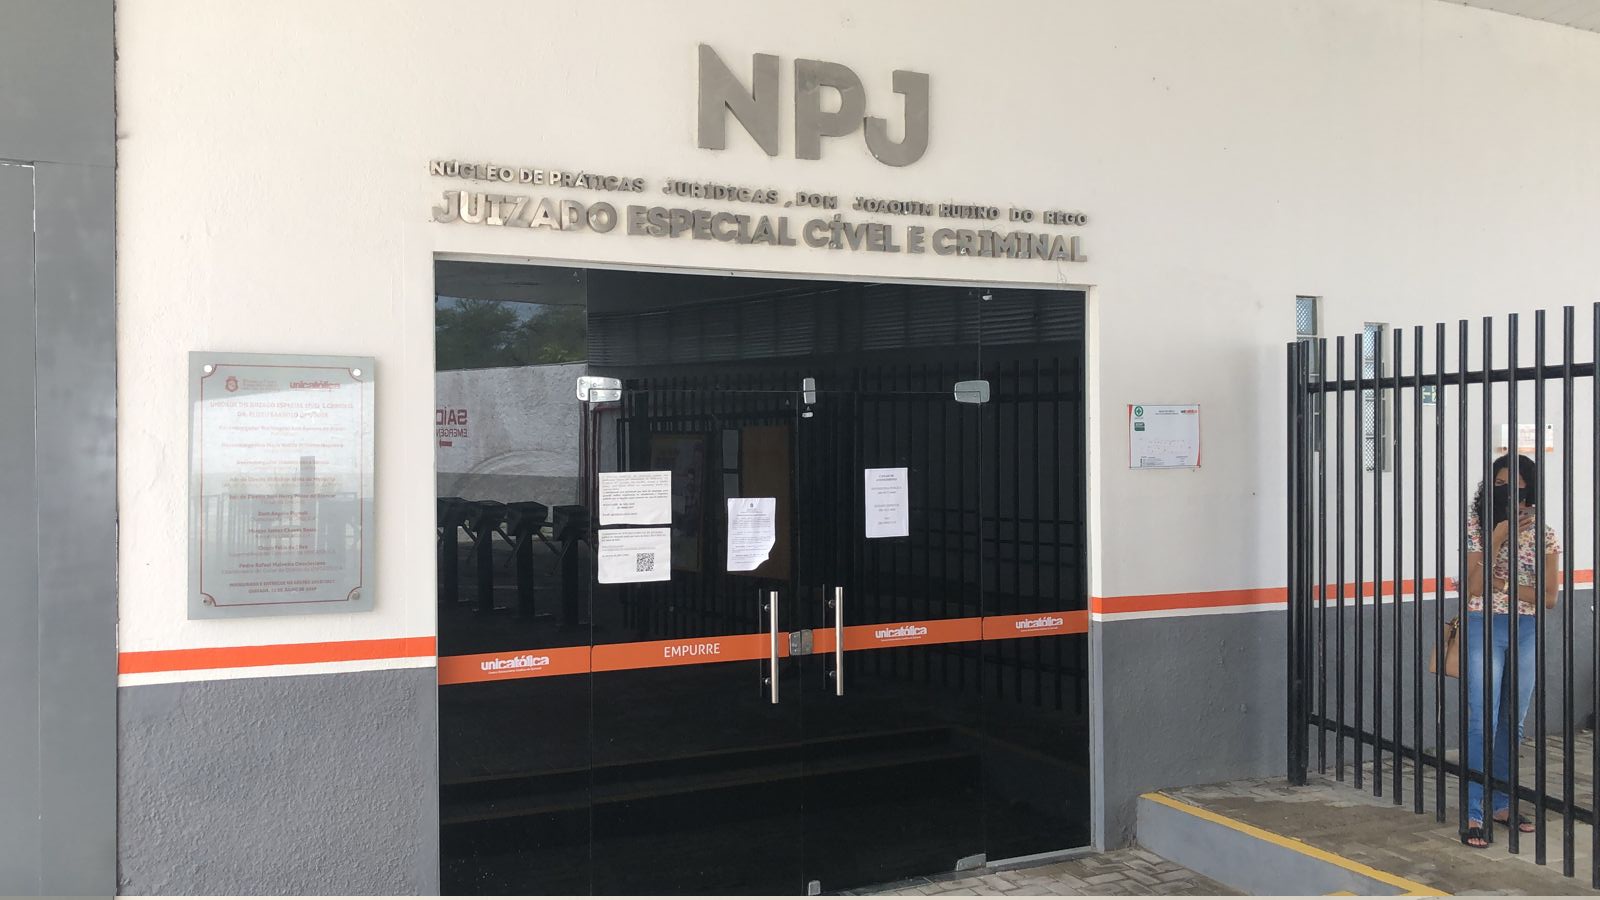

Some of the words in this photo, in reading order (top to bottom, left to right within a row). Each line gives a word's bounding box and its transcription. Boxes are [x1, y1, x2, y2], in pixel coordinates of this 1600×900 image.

[697, 42, 930, 167] NPJ
[430, 160, 514, 183] NÚCLEO
[519, 167, 544, 185] DE
[550, 170, 647, 193] PRÁTICAS
[795, 191, 838, 210] DOM
[853, 196, 934, 217] JOAQUIM
[1009, 207, 1035, 223] DO
[431, 190, 618, 234] JUIZADO
[626, 204, 797, 246] ESPECIAL
[802, 213, 901, 253] CÍVEL
[906, 225, 925, 254] E
[932, 228, 1088, 262] CRIMINAL
[1015, 616, 1064, 629] unicatólica
[875, 625, 928, 639] unicatólica
[663, 643, 721, 658] EMPURRE
[480, 655, 550, 671] unicatólica
